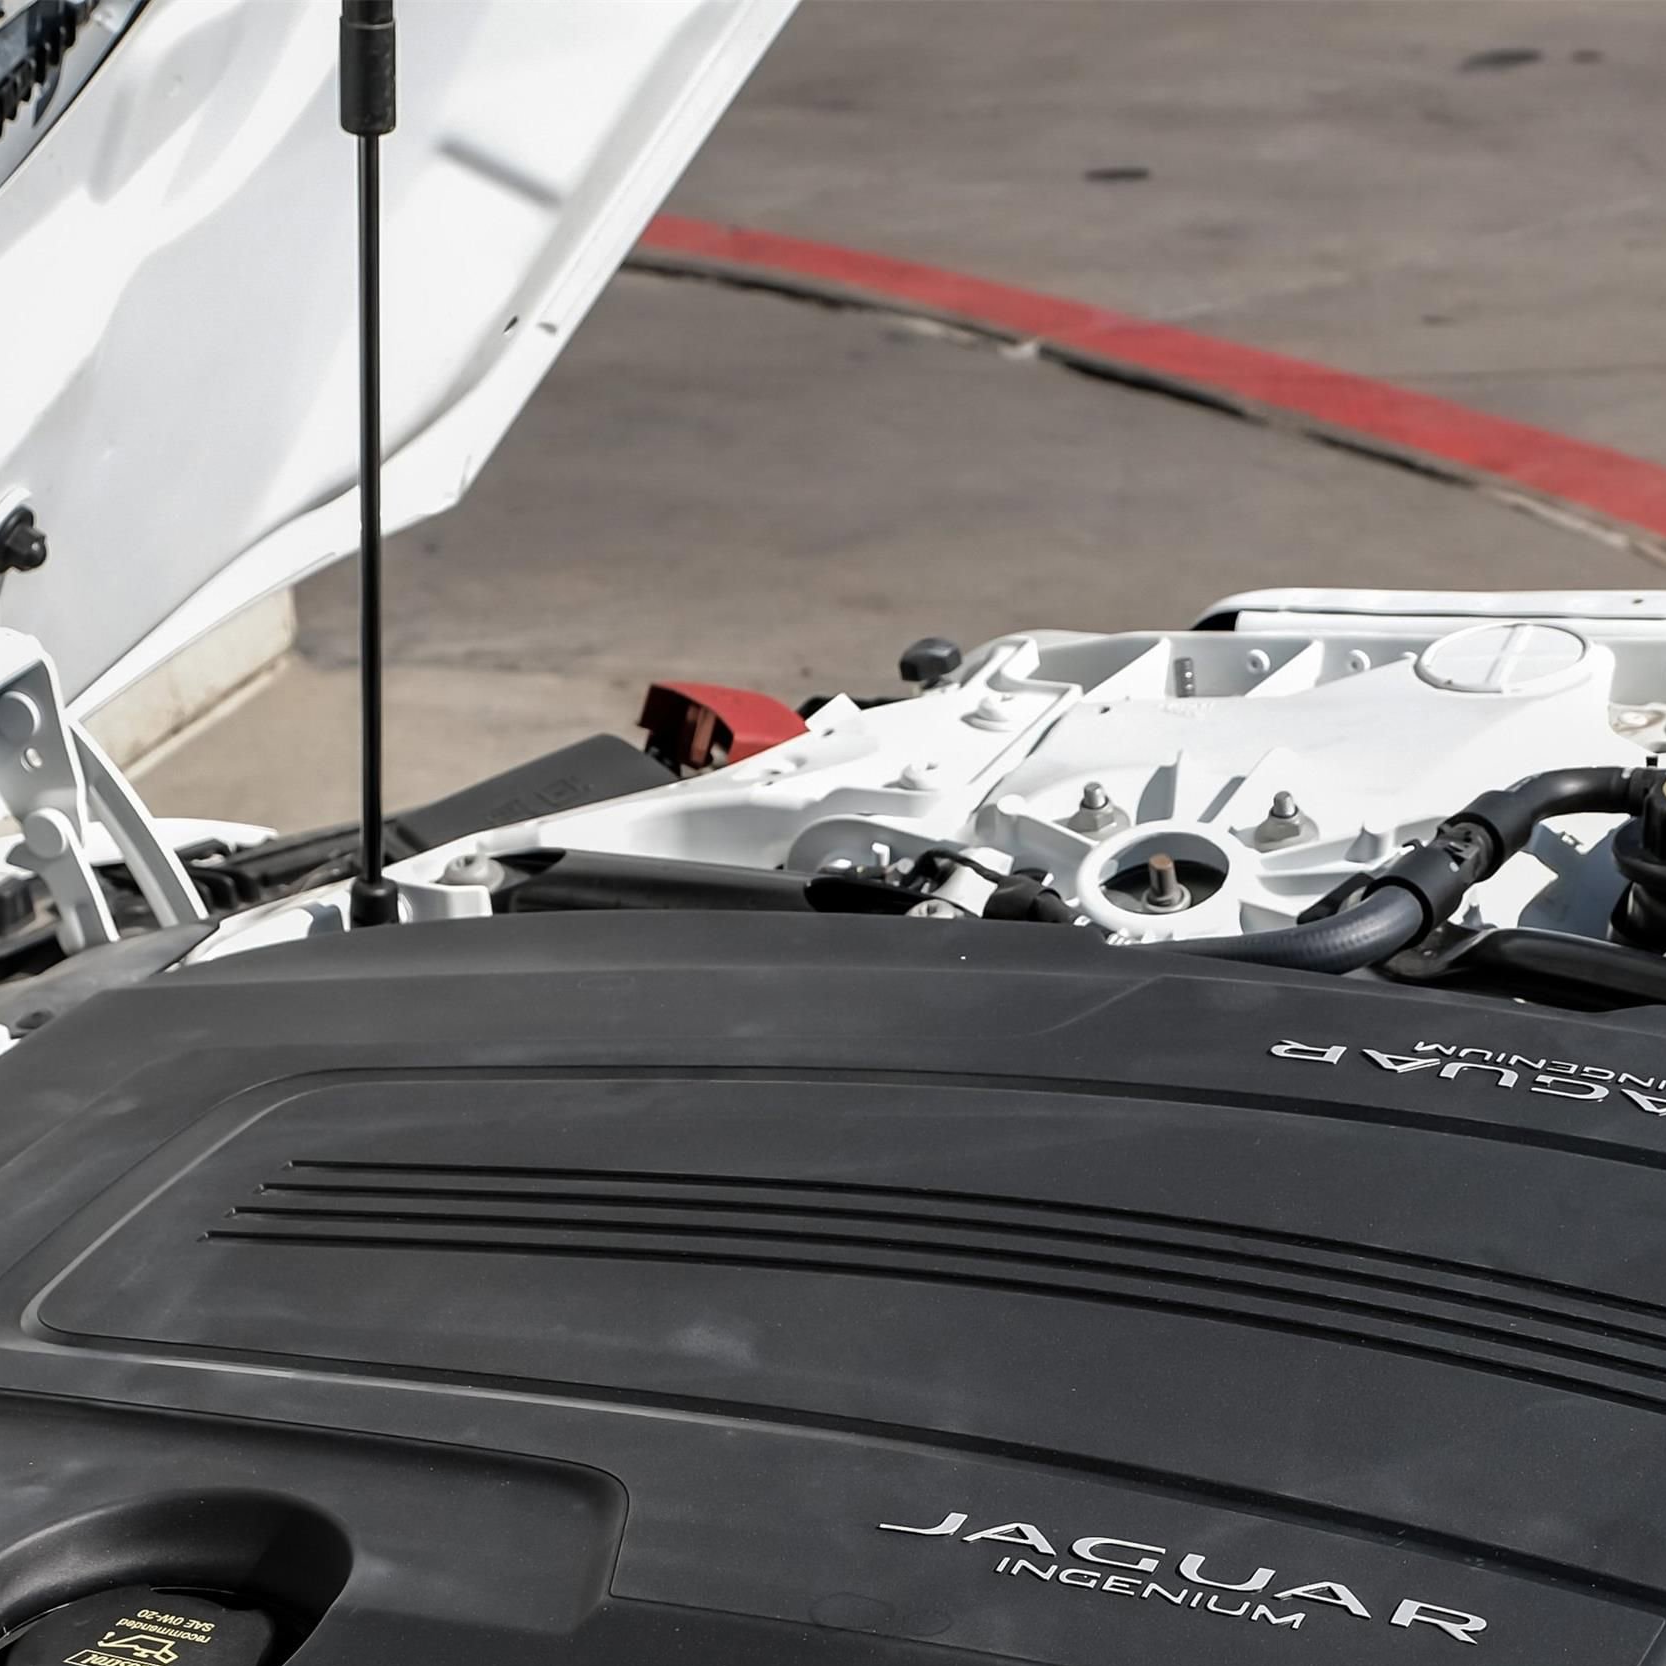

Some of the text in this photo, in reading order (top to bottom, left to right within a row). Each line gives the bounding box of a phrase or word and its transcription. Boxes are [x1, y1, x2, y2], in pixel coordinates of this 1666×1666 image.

[1413, 1040, 1666, 1091] INGENIUM
[879, 1511, 1488, 1645] JAGUAR
[996, 1556, 1306, 1630] INGENIUM
[115, 1617, 211, 1644] recommended
[136, 1608, 216, 1632] SAE 0W-20
